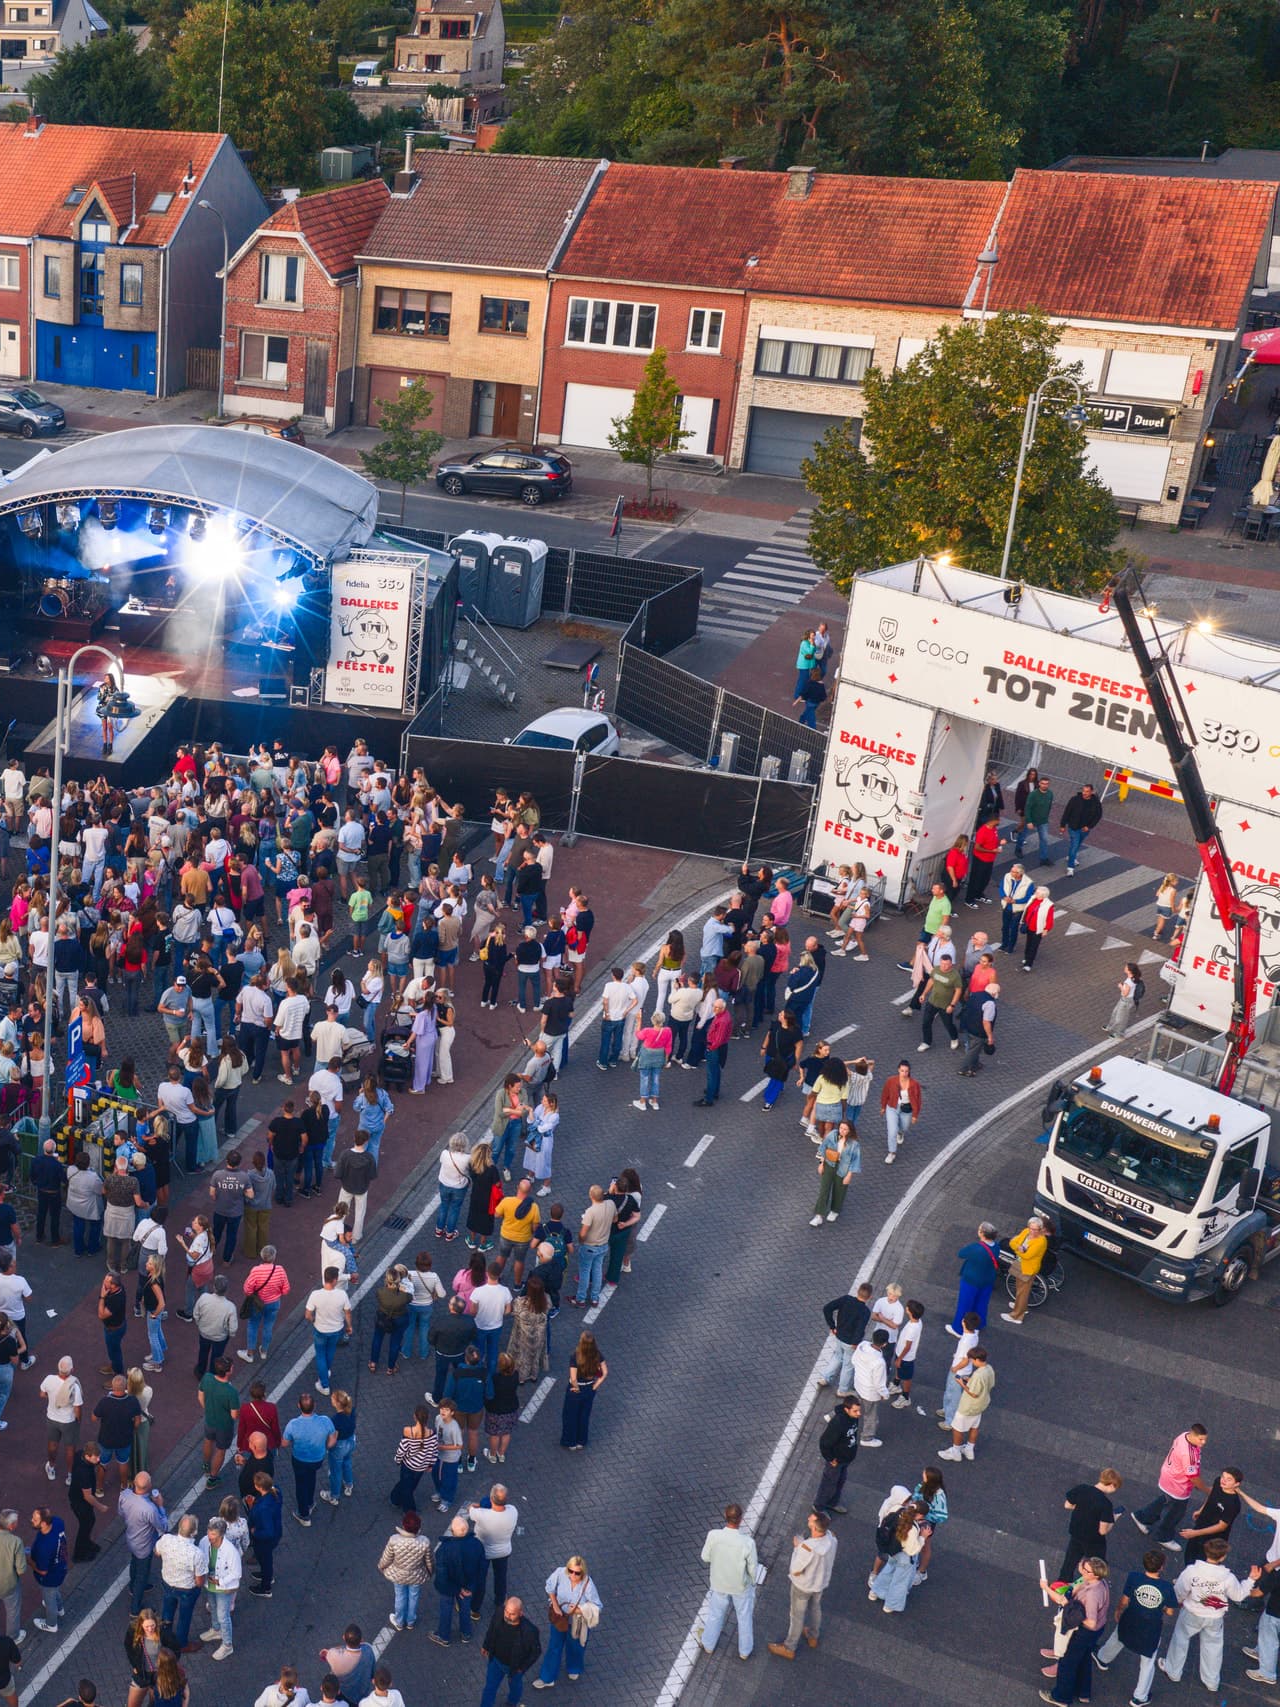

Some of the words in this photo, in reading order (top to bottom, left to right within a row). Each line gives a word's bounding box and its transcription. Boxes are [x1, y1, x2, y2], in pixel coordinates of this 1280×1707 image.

[1135, 414, 1164, 428] Duvel
[378, 578, 405, 590] 360
[340, 597, 399, 611] BALLEKES
[865, 638, 881, 650] VAN
[883, 643, 905, 657] TRIER
[870, 650, 896, 665] GROEP
[336, 660, 395, 674] FEESTEN
[982, 666, 1056, 709] TOT
[840, 730, 916, 766] BALLEKES
[1200, 718, 1261, 754] 360
[824, 820, 899, 857] FEESTEN
[71, 1025, 81, 1055] P
[1100, 1100, 1176, 1139] BOUWWERKEN
[1079, 1174, 1153, 1214] VANDEWEYER
